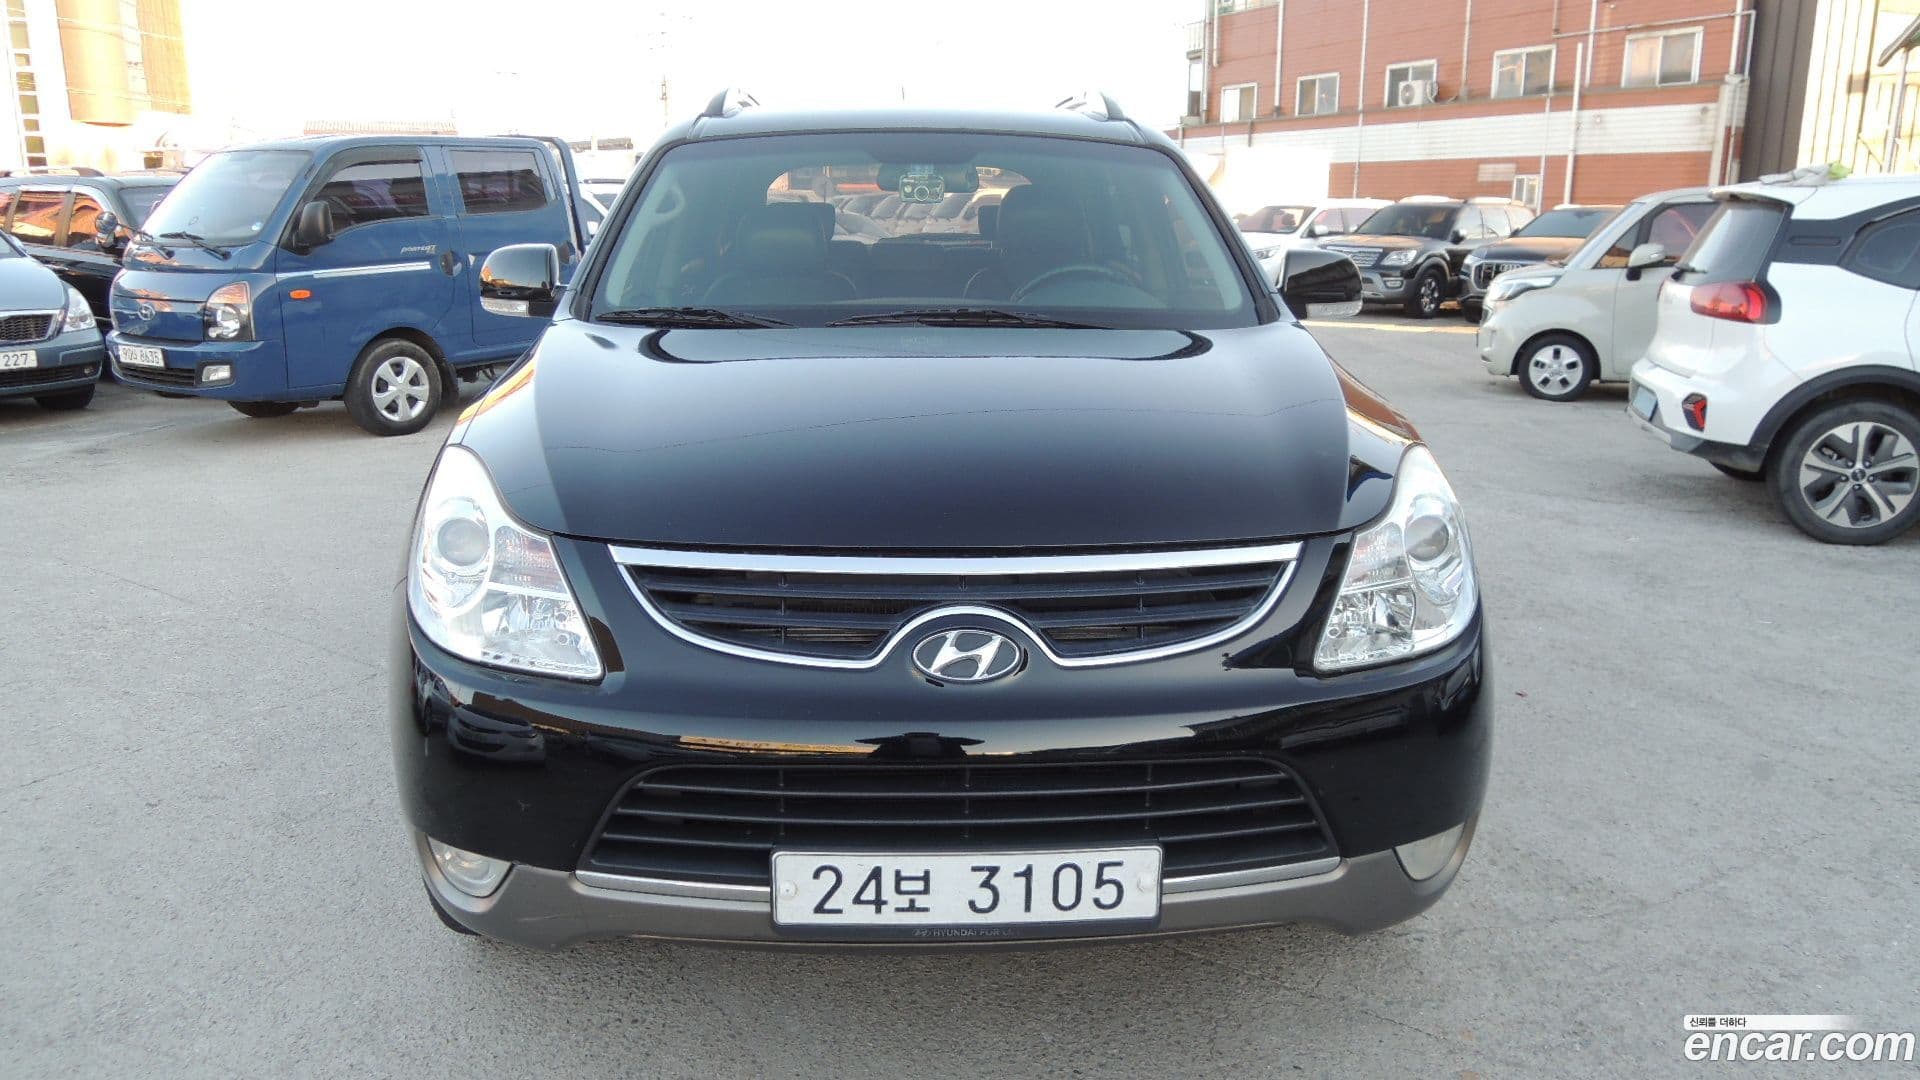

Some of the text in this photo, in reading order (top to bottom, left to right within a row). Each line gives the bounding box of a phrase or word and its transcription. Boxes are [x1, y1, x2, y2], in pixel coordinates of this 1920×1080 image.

[3, 353, 28, 367] 227
[812, 860, 1124, 915] 24보 3105
[933, 927, 978, 937] HYUNDAI
